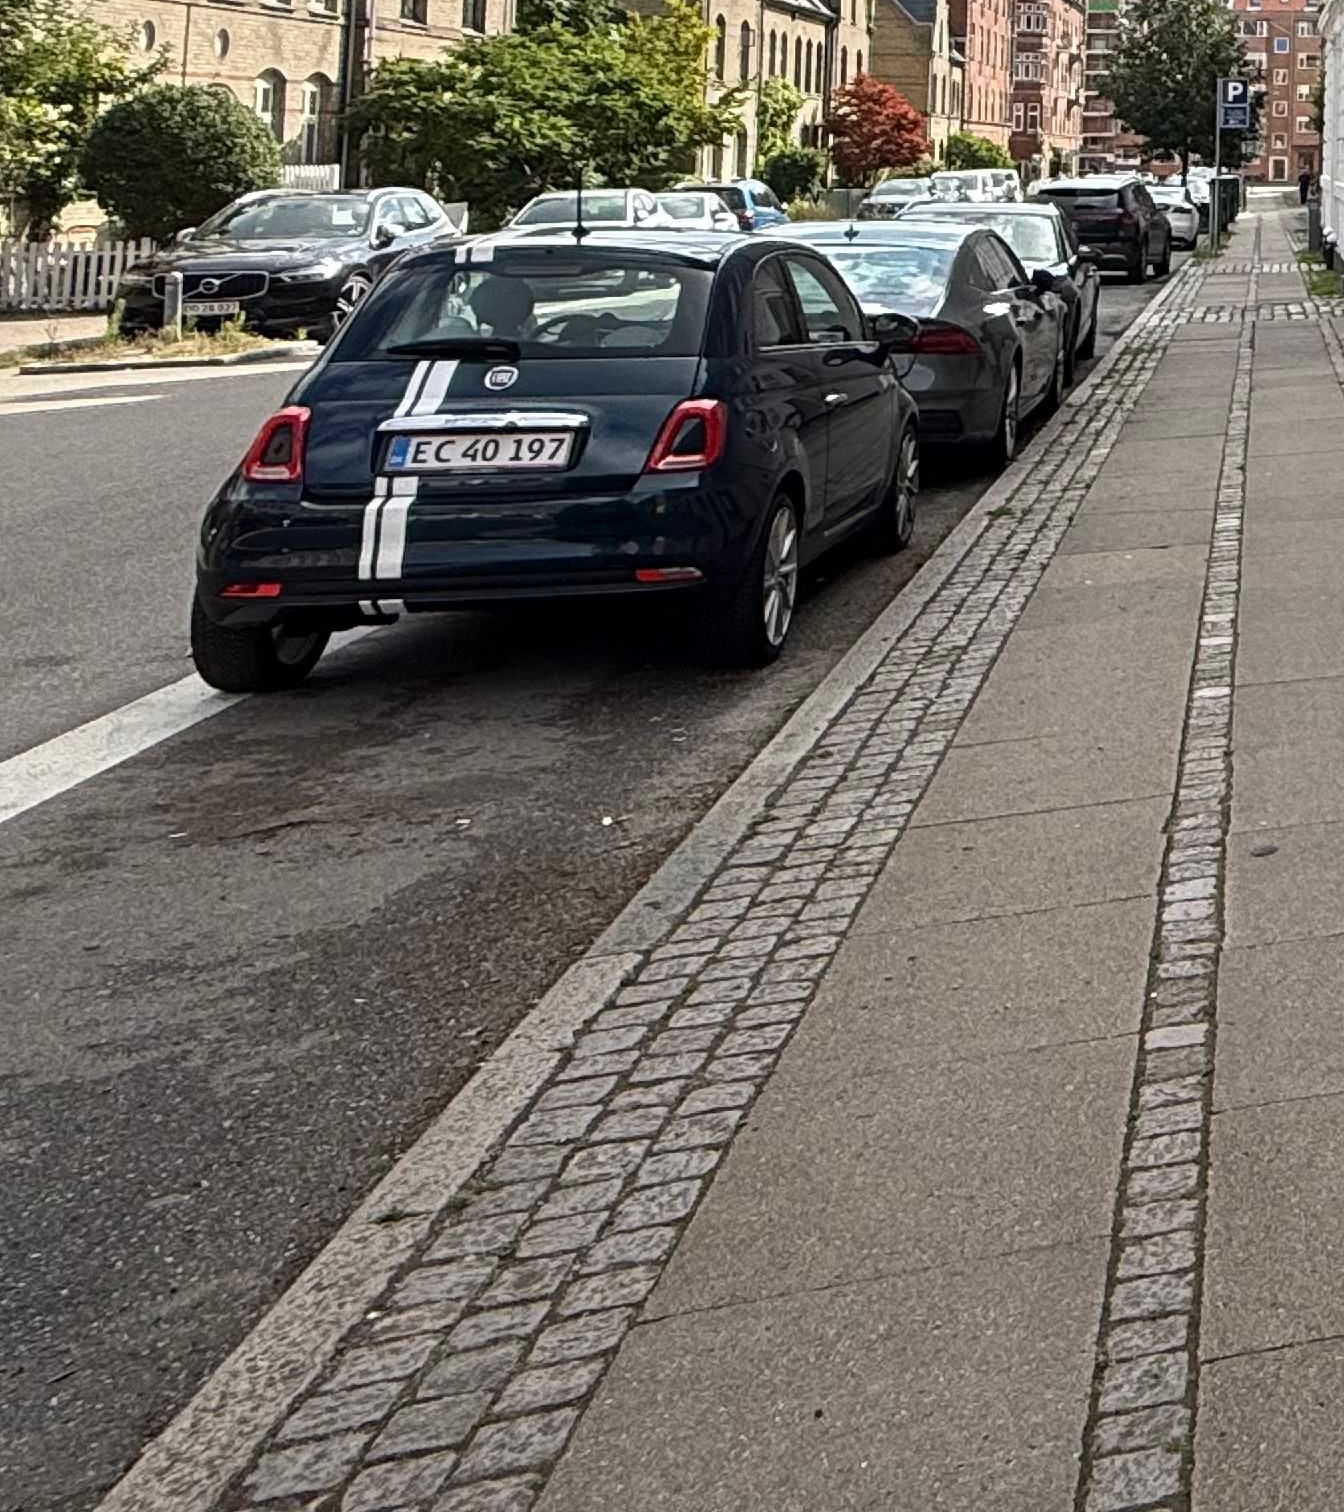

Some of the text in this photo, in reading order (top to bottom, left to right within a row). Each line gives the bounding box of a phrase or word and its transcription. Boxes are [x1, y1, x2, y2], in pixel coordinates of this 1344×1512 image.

[1227, 82, 1244, 102] P
[411, 440, 455, 464] EC
[461, 438, 499, 463] 40
[509, 438, 566, 462] 197
